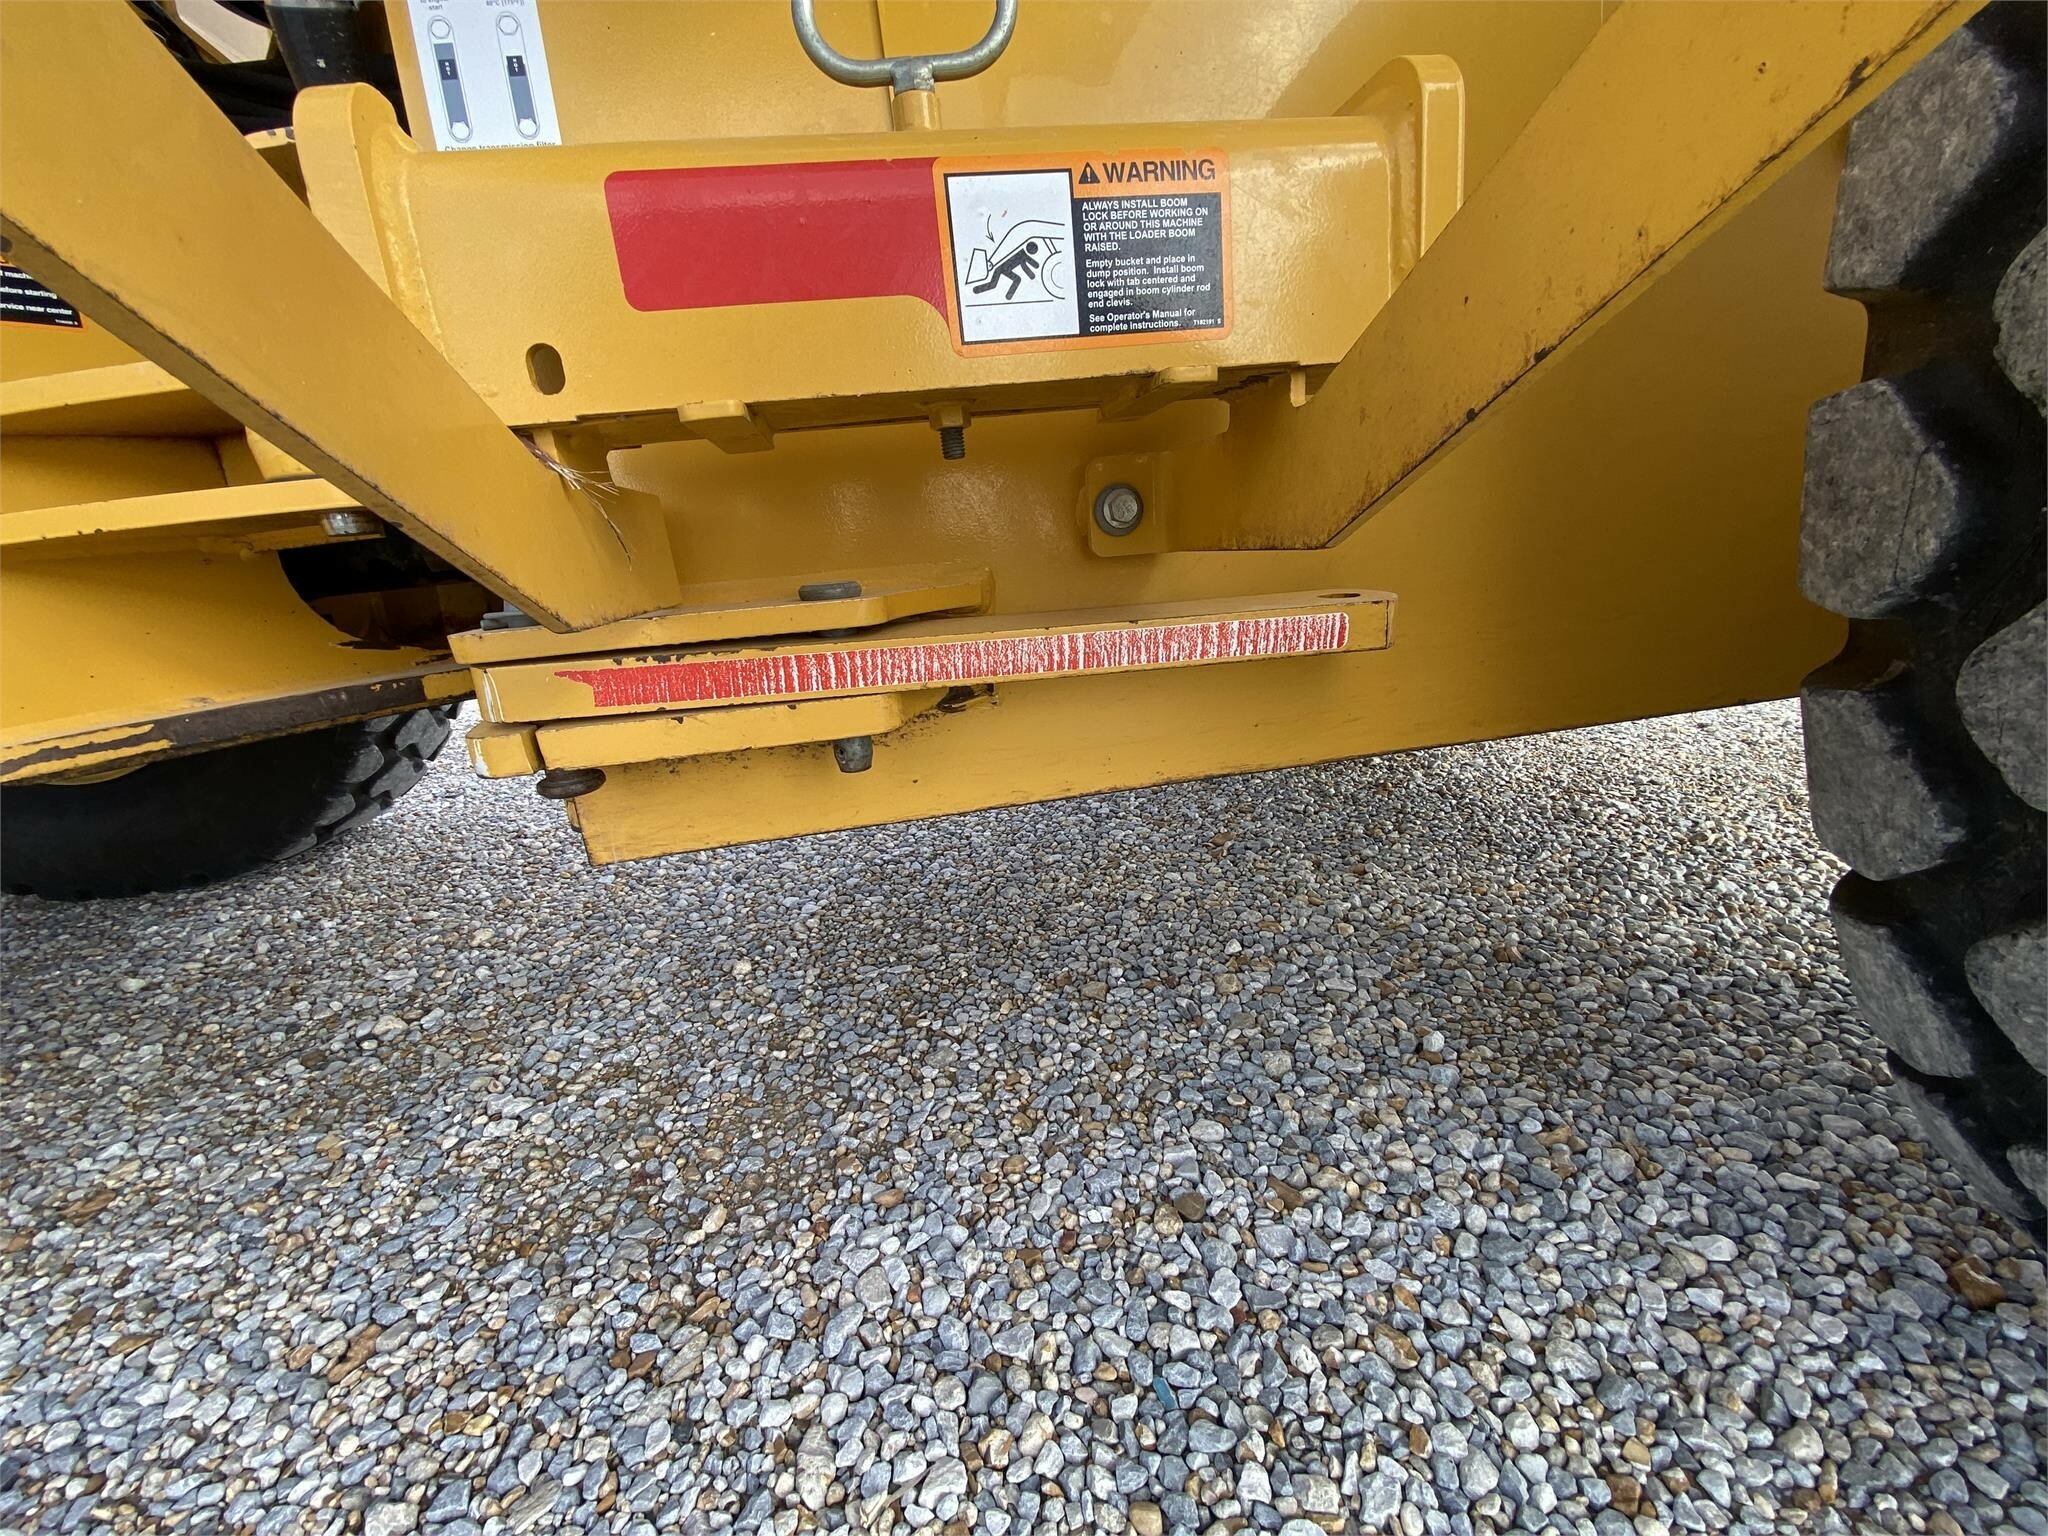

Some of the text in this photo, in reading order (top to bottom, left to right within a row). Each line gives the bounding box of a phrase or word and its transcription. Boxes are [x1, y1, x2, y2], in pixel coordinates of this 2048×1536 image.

[1103, 159, 1215, 183] WARNING
[1082, 198, 1188, 211] ALWAYS INSTALL BOOM
[1082, 207, 1208, 221] LOCK BEFORE WORKING ON
[1083, 218, 1203, 231] OR AROUND THIS MACHINE
[1084, 228, 1196, 242] WITH THE LOADER BOOM
[1085, 242, 1121, 252] RAISED.
[1085, 254, 1196, 269] Empty bucket and place in
[1086, 264, 1205, 279] dump position. Install boom
[1087, 274, 1196, 288] lock with tab centered and
[0, 286, 57, 299] efore starting
[1087, 283, 1211, 299] engaged in boom cylinder rod
[0, 303, 24, 311] ervice
[46, 307, 72, 315] center
[1088, 298, 1133, 308] end clevis.
[1089, 308, 1196, 323] See Operator's Manual for
[1089, 320, 1181, 333] complete instructions.
